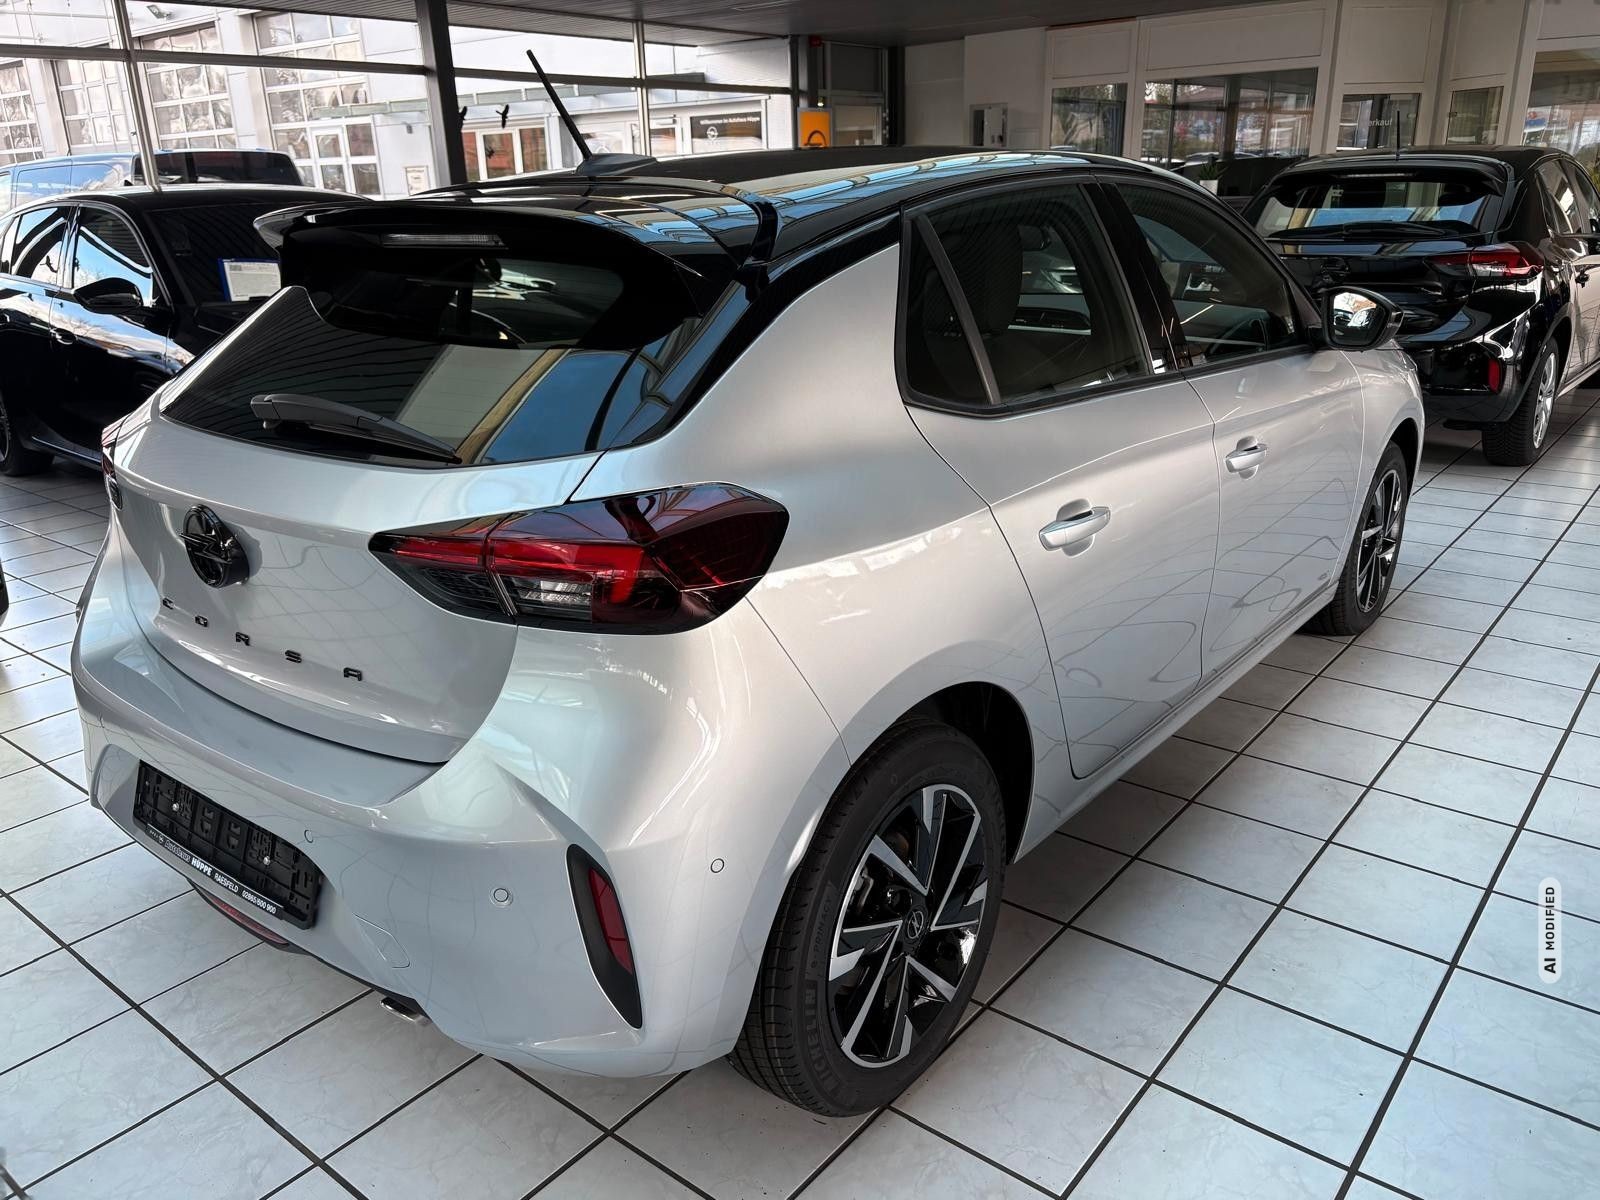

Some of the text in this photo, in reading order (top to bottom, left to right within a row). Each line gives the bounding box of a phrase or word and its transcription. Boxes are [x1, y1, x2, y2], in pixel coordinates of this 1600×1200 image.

[162, 597, 362, 681] CORSA
[191, 857, 213, 876] HÜPPE
[214, 873, 239, 893] RAESFELD
[266, 904, 277, 914] 900
